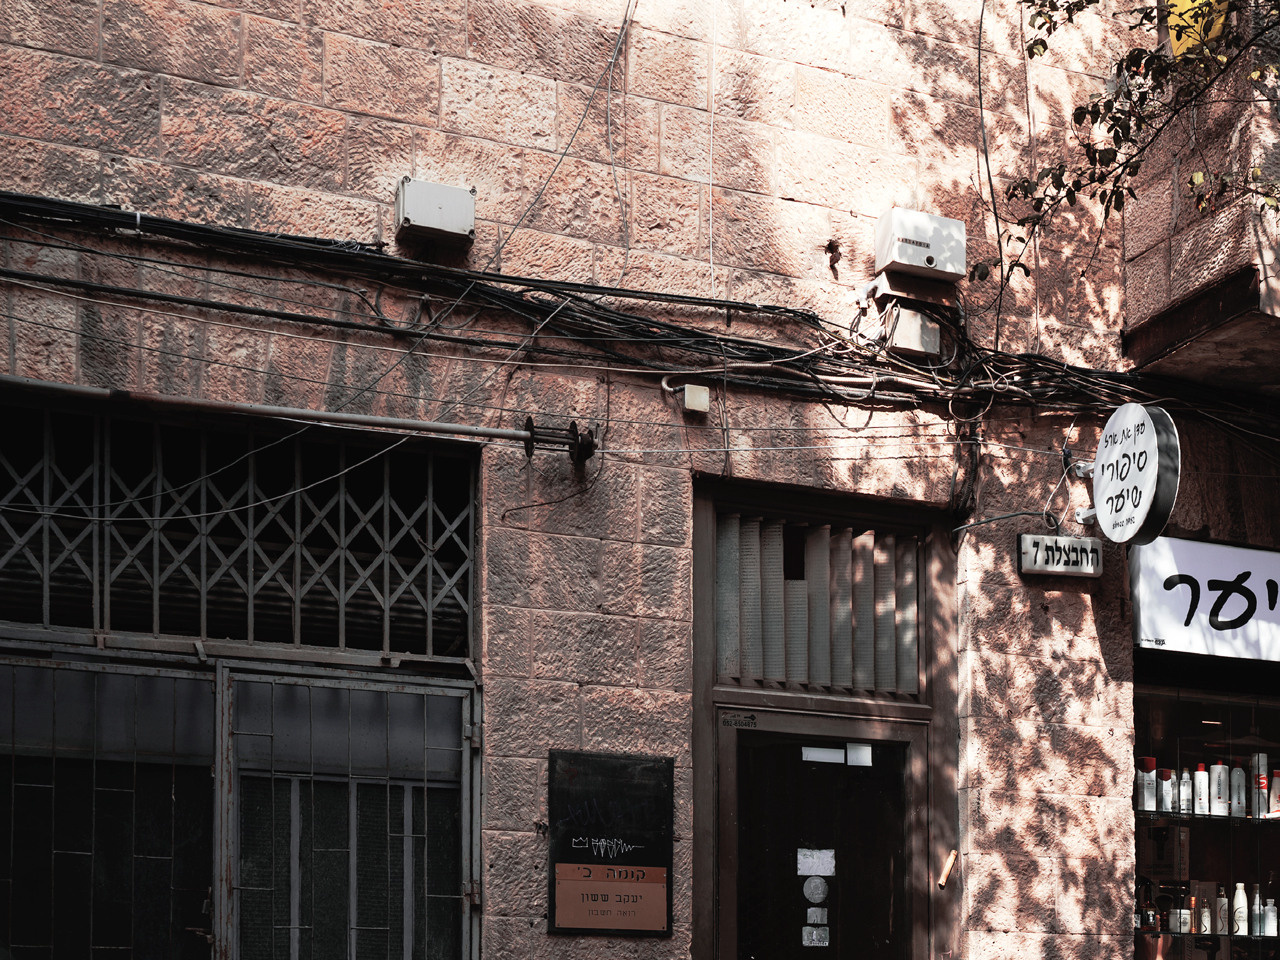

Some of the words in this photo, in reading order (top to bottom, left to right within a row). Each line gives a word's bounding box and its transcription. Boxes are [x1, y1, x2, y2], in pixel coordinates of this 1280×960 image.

[1100, 450, 1149, 482] סיפורי
[1105, 485, 1143, 516] שיער
[1032, 539, 1041, 567] 7
[1044, 538, 1100, 568] החבצלת
[606, 868, 646, 882] קומה
[581, 893, 609, 904] ששון
[615, 894, 643, 905] יעקב
